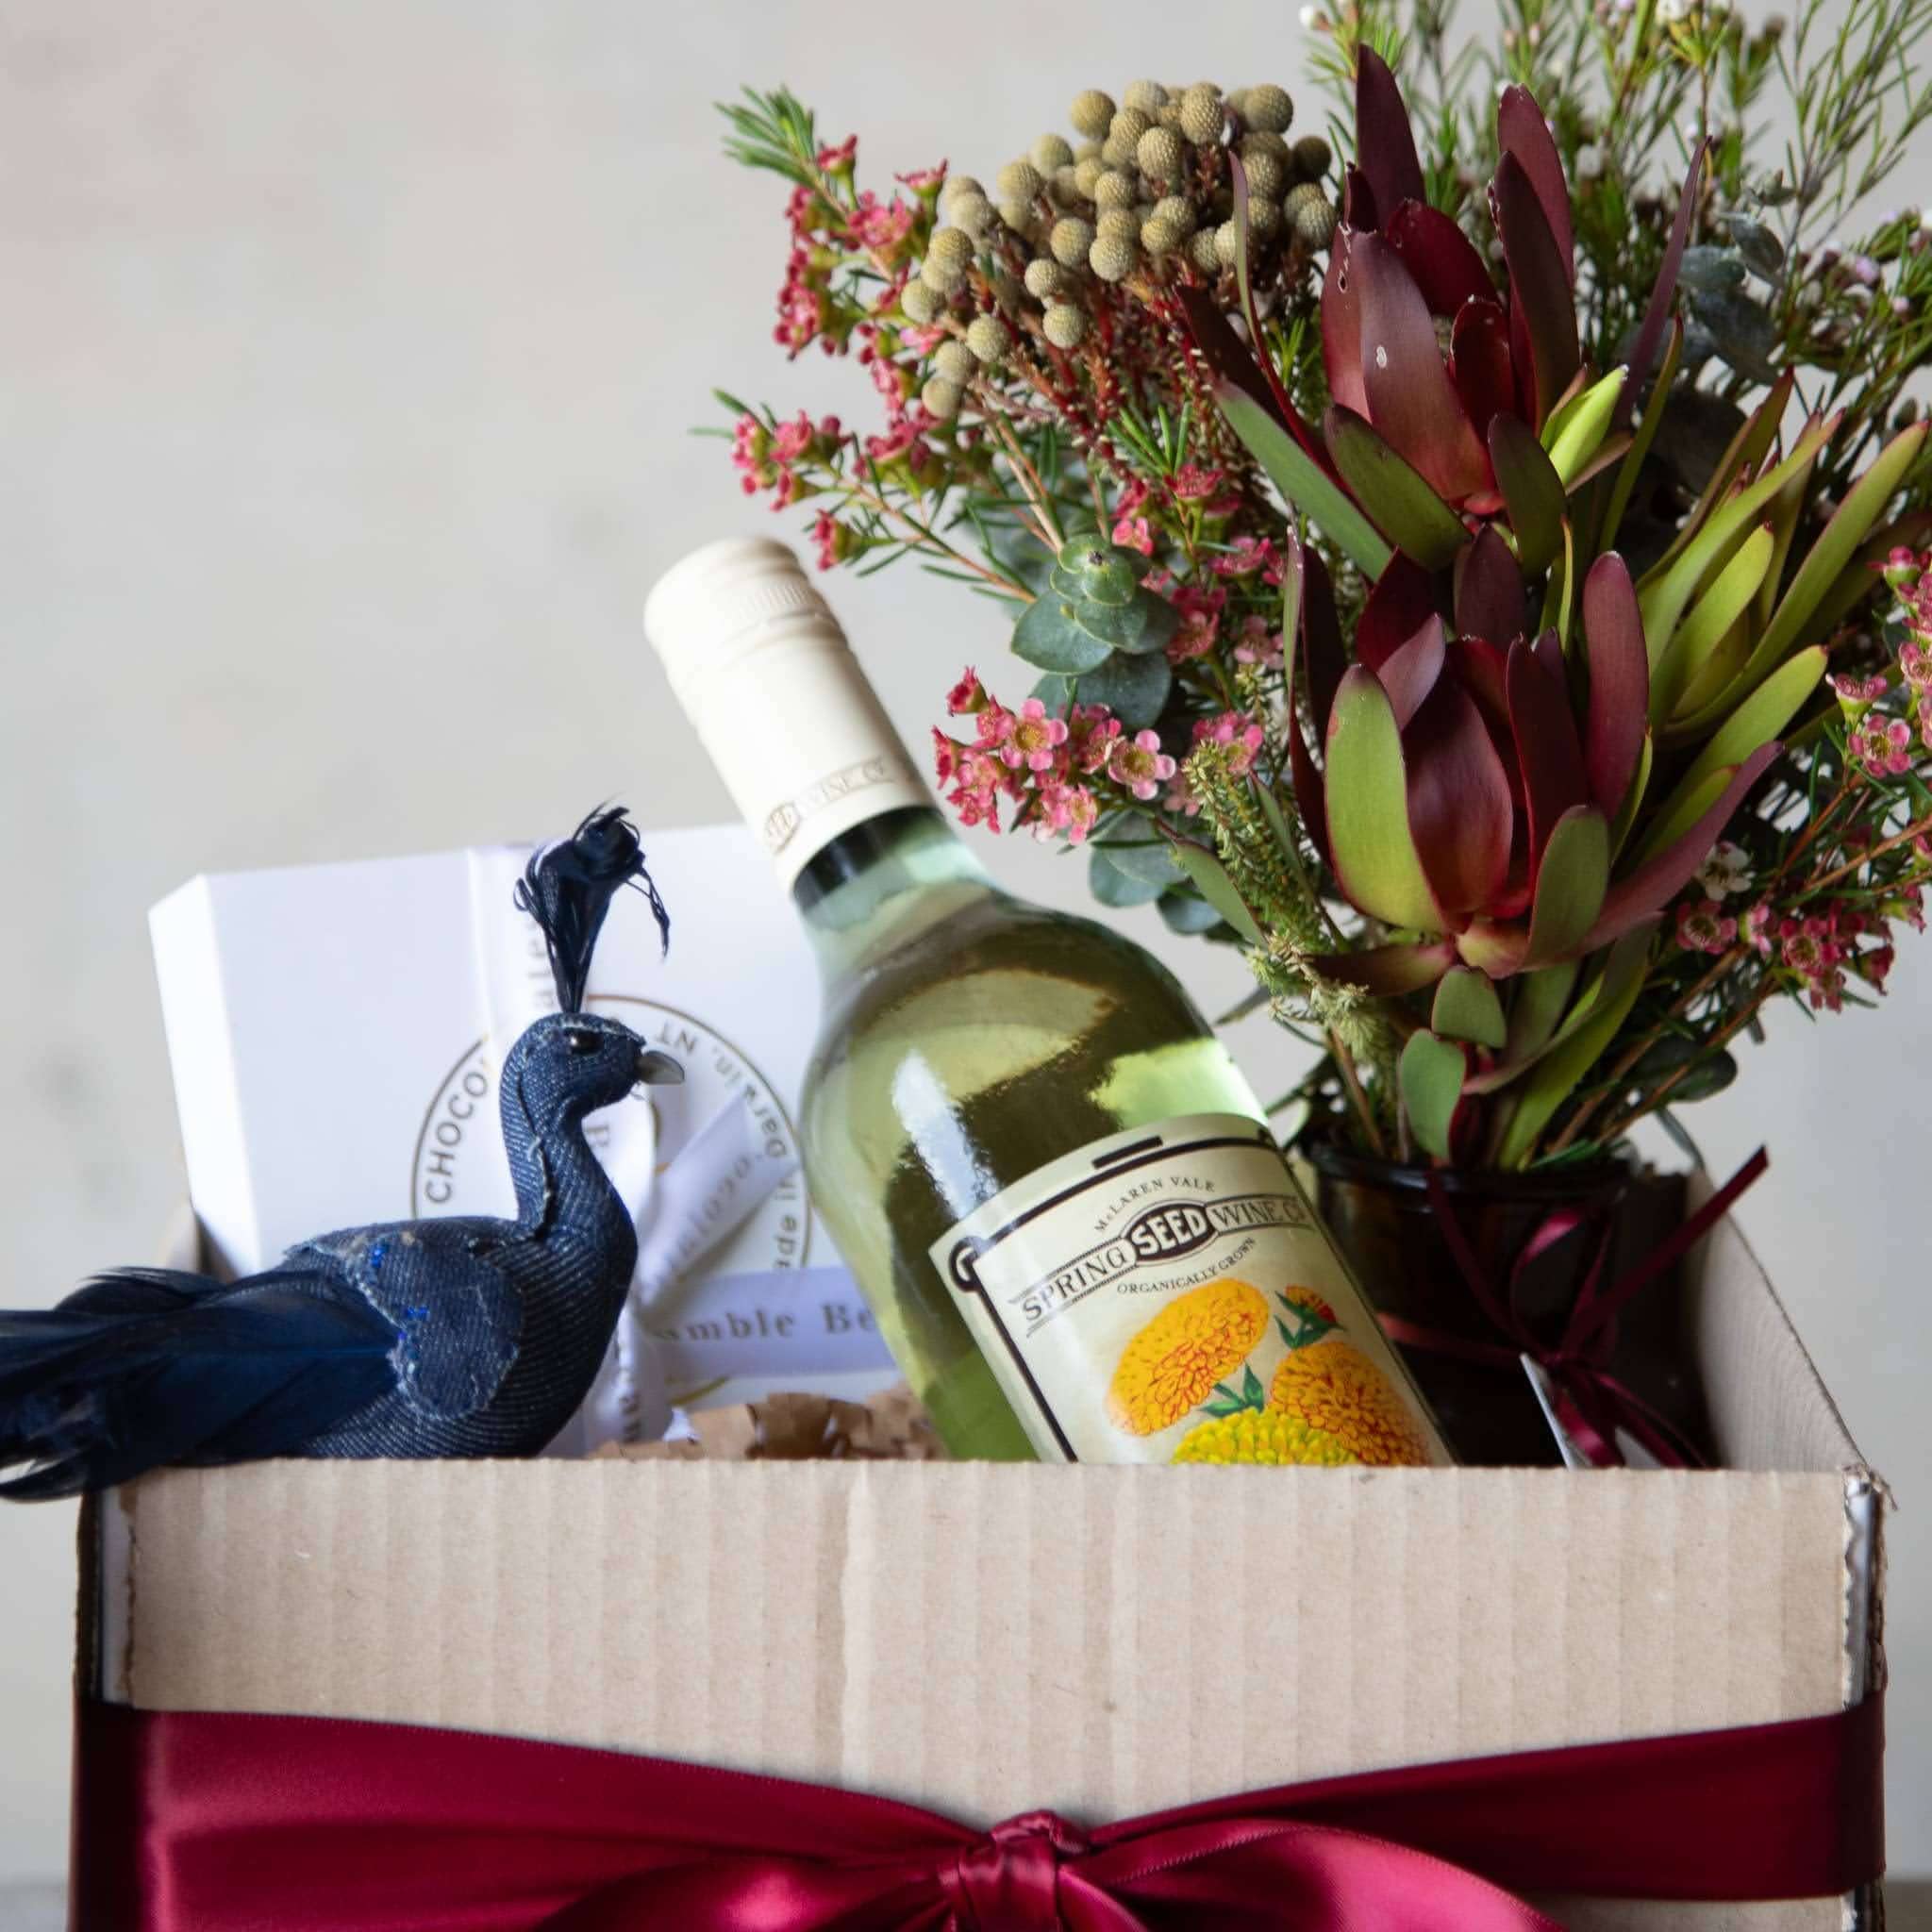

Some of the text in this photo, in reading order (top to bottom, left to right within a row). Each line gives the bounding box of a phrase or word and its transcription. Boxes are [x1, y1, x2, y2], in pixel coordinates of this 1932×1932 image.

[425, 1070, 490, 1205] CHOCO
[1170, 1175, 1216, 1193] VALE
[1022, 1245, 1127, 1322] SPRING
[1131, 1208, 1208, 1256] SEED
[1211, 1200, 1284, 1226] WINE
[1116, 1236, 1257, 1294] ORGANICALLY GROWN
[821, 1302, 876, 1334] Be
